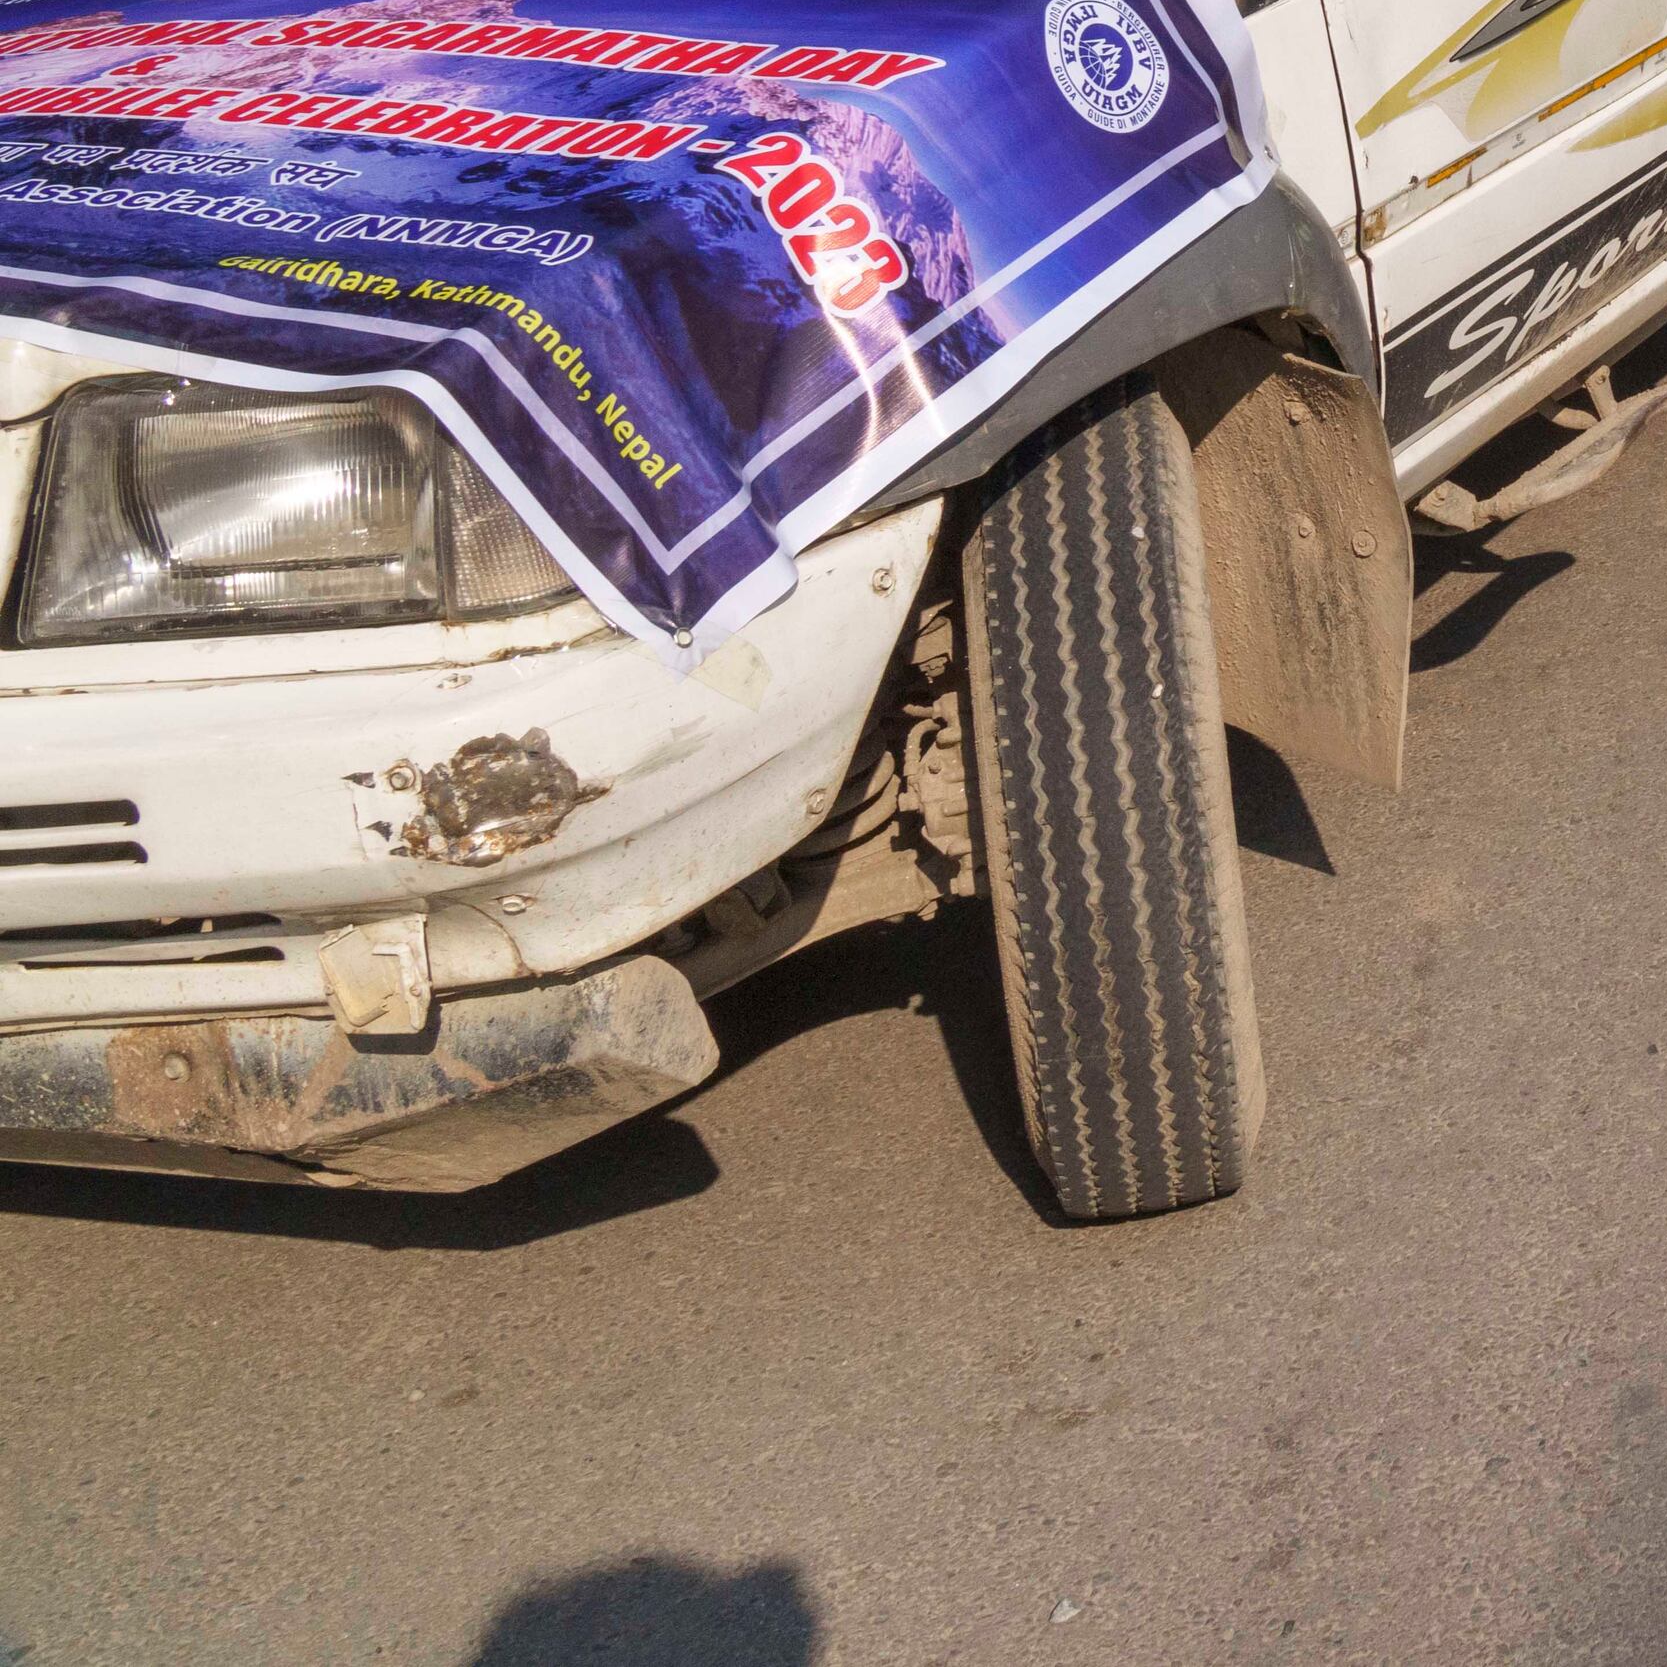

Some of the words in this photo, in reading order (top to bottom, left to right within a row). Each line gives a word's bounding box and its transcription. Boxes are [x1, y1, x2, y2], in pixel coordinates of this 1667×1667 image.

[1048, 6, 1062, 37] GUIDE
[1063, 5, 1098, 64] IFMGA
[1116, 15, 1152, 70] IVBV
[0, 19, 272, 56] ATIONAL
[250, 18, 779, 77] SAGARMATHA
[750, 46, 947, 91] DAY
[108, 53, 180, 78] &
[1054, 66, 1077, 101] GUIDA
[1081, 79, 1143, 111] UIAGM
[1087, 109, 1114, 129] GUIDE
[1129, 81, 1165, 126] MONTAGNE
[42, 144, 125, 176] पथ
[270, 159, 362, 192] संघ
[0, 178, 323, 234] Association
[315, 212, 594, 266] (NNMGA)
[215, 91, 708, 161] CELEBRATION
[714, 131, 910, 320] 2023
[218, 254, 401, 301] Gairidhara,
[408, 278, 594, 403] Kathmandu,
[595, 392, 683, 490] Nepal
